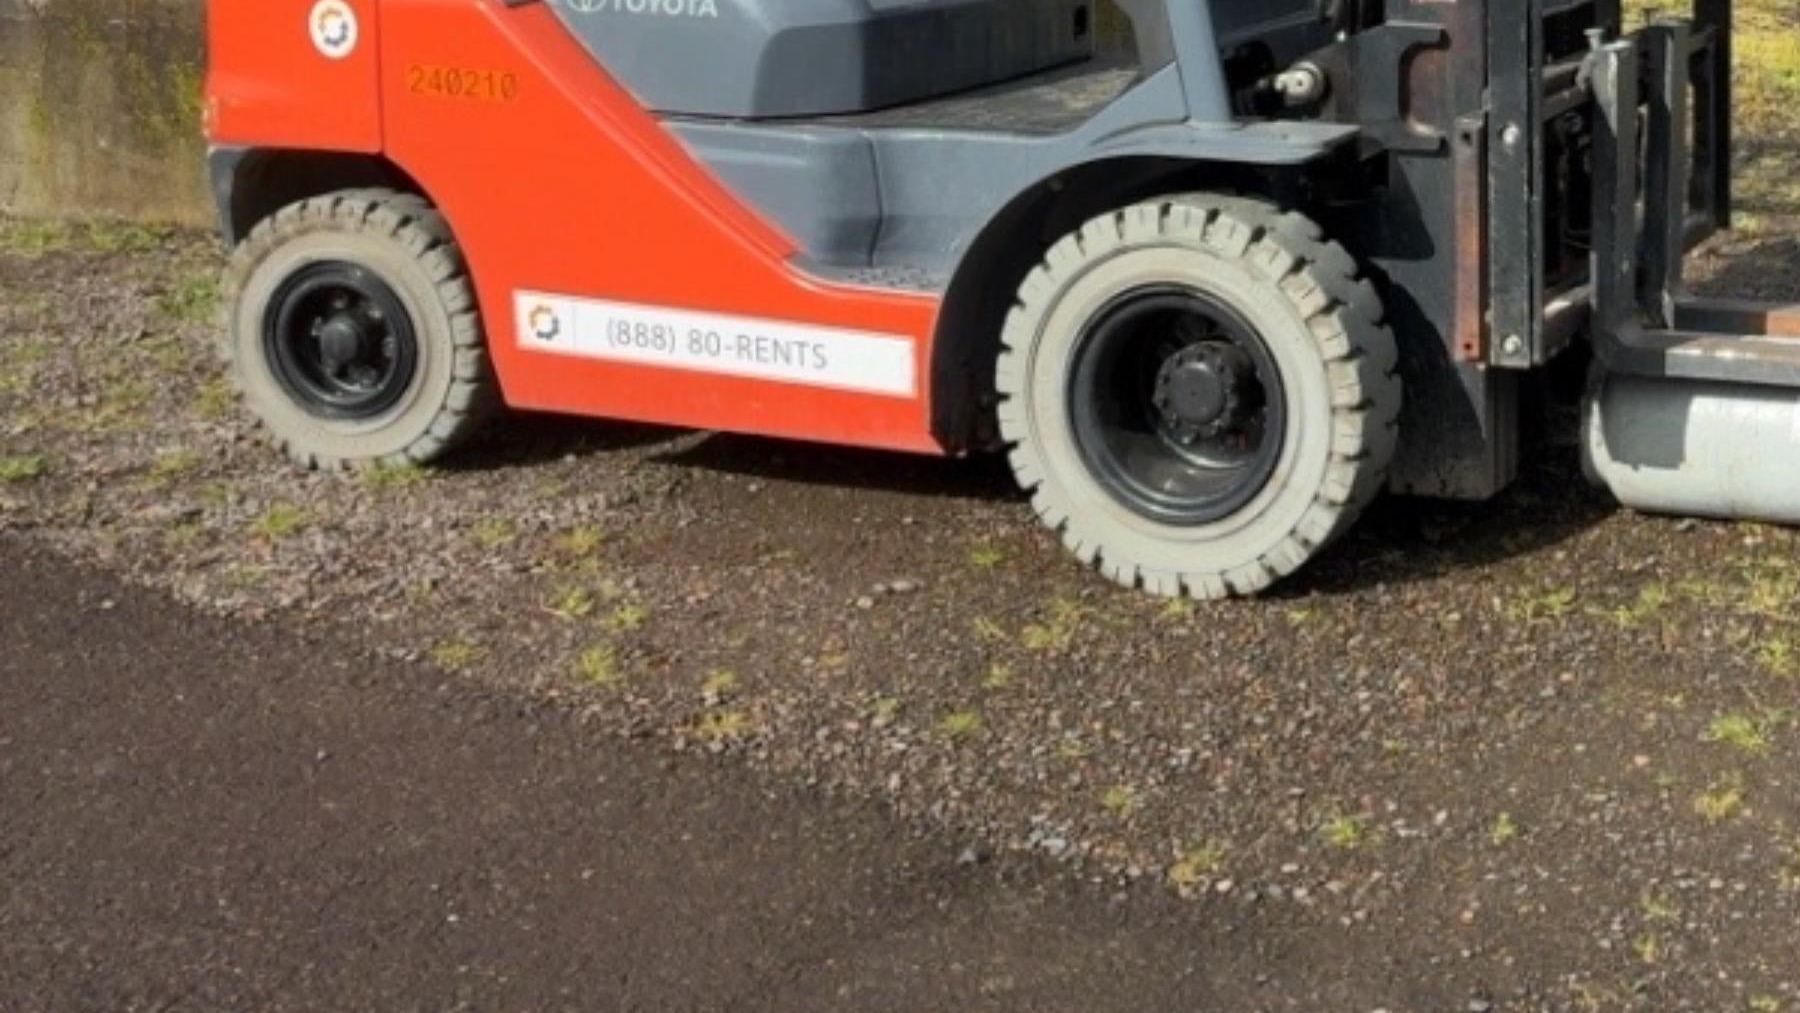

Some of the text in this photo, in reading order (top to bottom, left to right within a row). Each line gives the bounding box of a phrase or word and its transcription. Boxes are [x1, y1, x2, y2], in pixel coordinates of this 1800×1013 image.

[410, 65, 518, 100] 240210
[606, 316, 829, 371] (888) 80-RENTS
